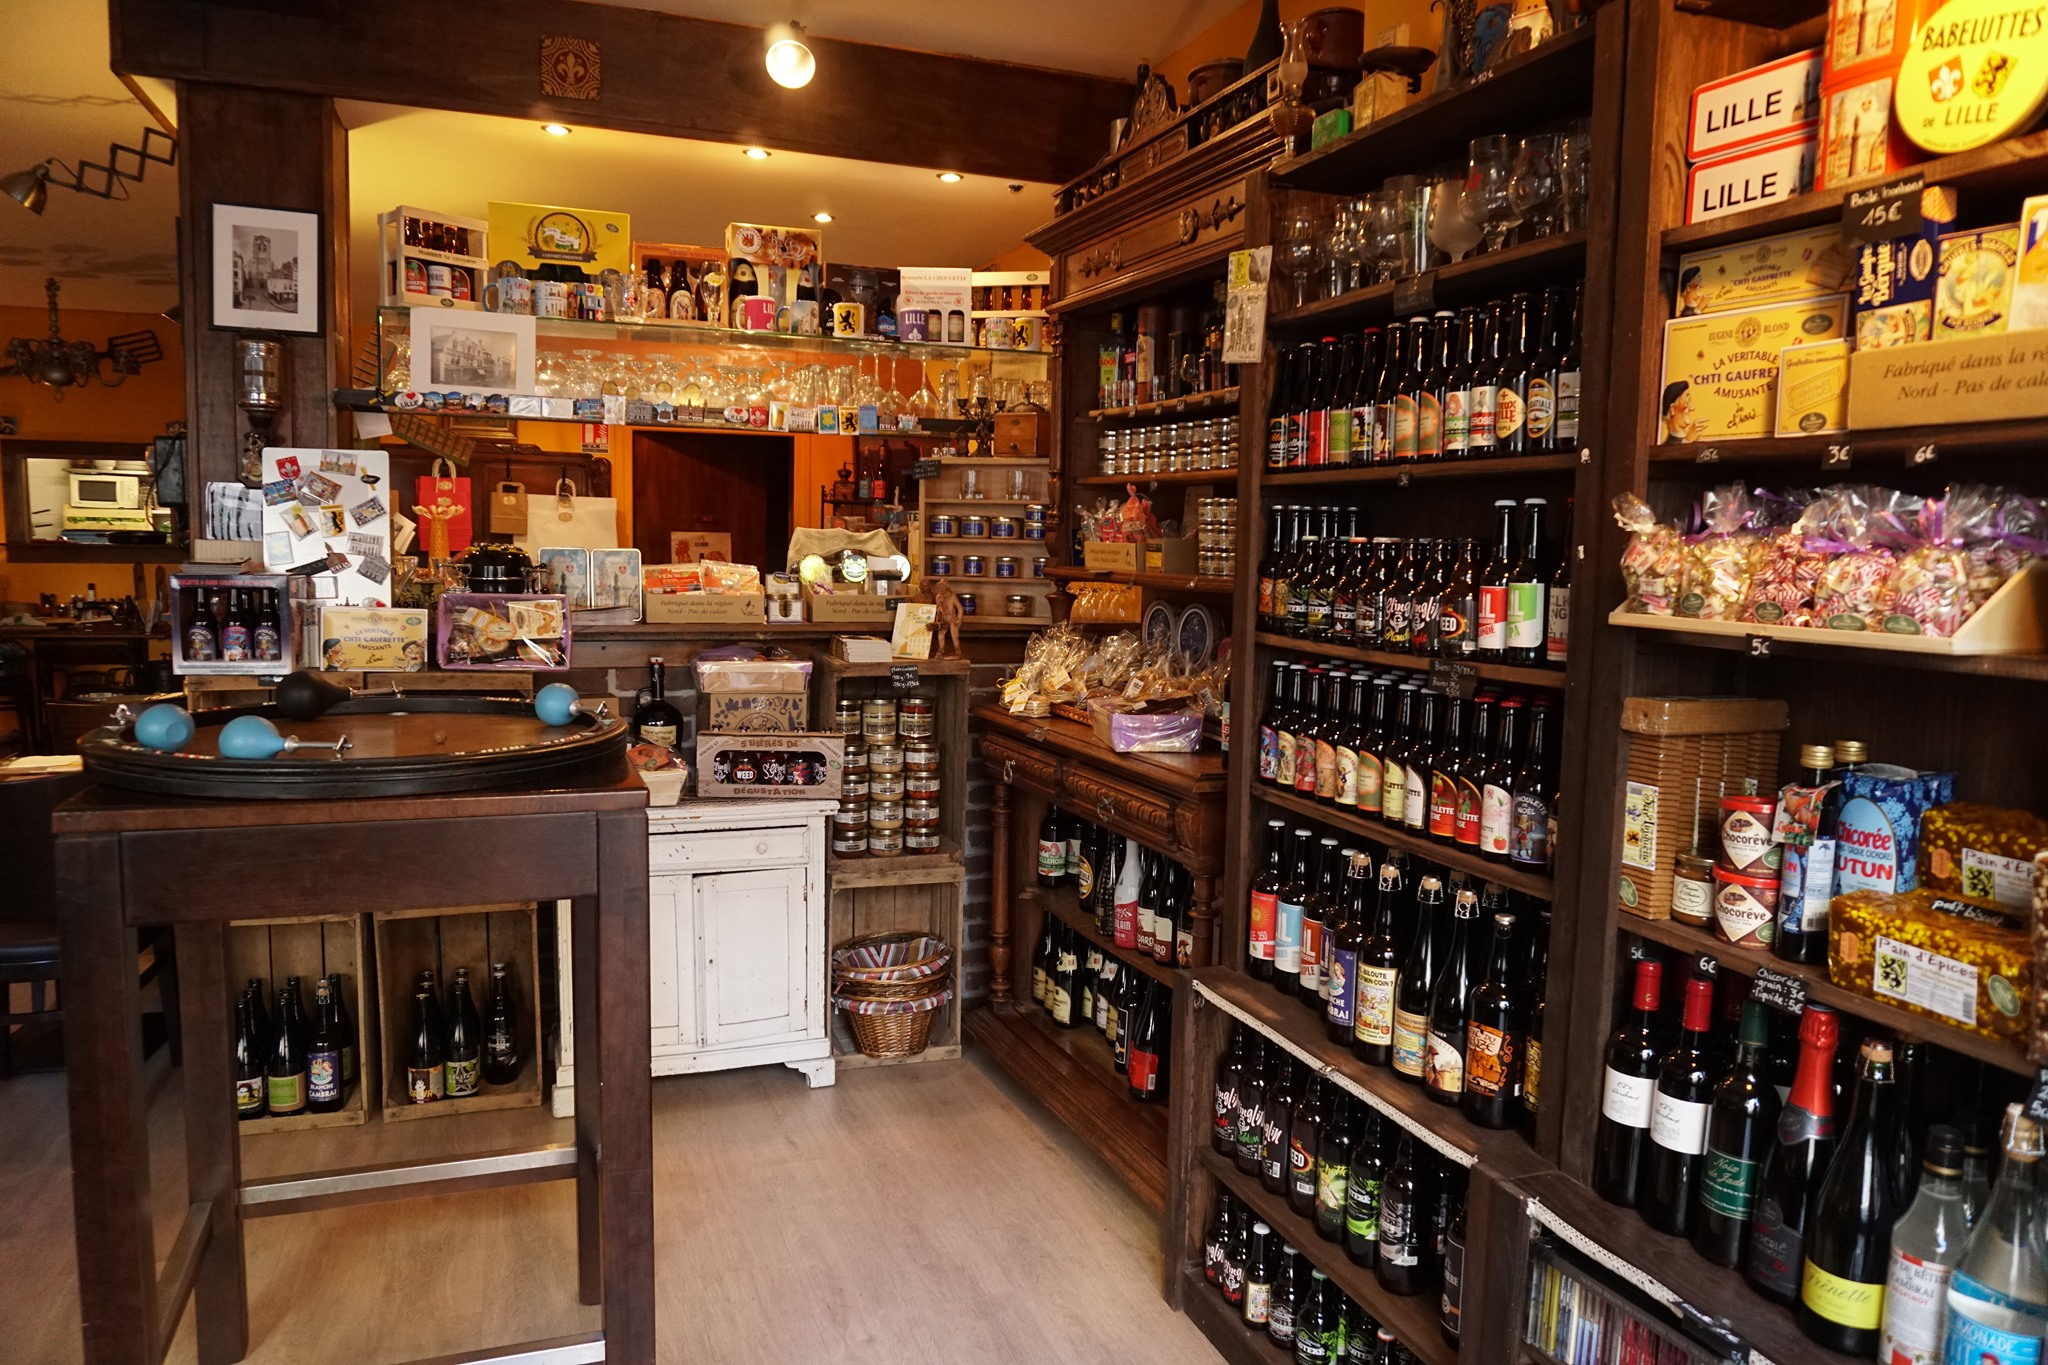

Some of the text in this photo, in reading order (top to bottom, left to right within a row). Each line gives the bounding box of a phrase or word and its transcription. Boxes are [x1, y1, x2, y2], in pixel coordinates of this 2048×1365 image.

[1922, 6, 2047, 52] BABELUTTES
[1706, 90, 1783, 134] LILLE
[1944, 102, 2000, 126] LILLE
[1702, 171, 1779, 213] LILLE
[1861, 200, 1903, 227] 15€
[905, 313, 926, 325] LILLE
[1763, 322, 1790, 335] BLOND
[1713, 350, 1780, 370] LA VERITABLE
[1883, 356, 1955, 380] Fabriqué
[1959, 352, 2003, 372] dans
[2008, 347, 2025, 365] la
[1713, 383, 1774, 399] AMUSANTE
[1897, 382, 1937, 401] Nord
[1955, 379, 1984, 395] Pas
[1990, 374, 2012, 391] de
[1828, 446, 1850, 464] 3€
[1915, 444, 1936, 463] 6€
[660, 599, 688, 608] Fabriqué
[714, 600, 734, 608] région
[826, 600, 851, 608] Fabriqué
[363, 627, 395, 637] VERITABLE
[741, 740, 747, 748] 5
[786, 740, 799, 748] DE
[736, 770, 754, 779] WEED
[733, 786, 806, 796] DÉGUSTATION
[1517, 807, 1536, 816] NOËL
[1965, 850, 1998, 867] Pain
[1631, 946, 1645, 960] 5€
[1877, 937, 1979, 981] Pain d'Epices
[1699, 956, 1717, 974] 6€
[1373, 978, 1389, 987] COIN
[1757, 967, 1802, 989] Chicorée
[1789, 987, 1806, 1001] 3€
[1787, 999, 1804, 1014] 5€
[308, 1089, 337, 1099] CAMBRAI
[1714, 1158, 1740, 1174] Noix
[1717, 1171, 1746, 1190] Jade
